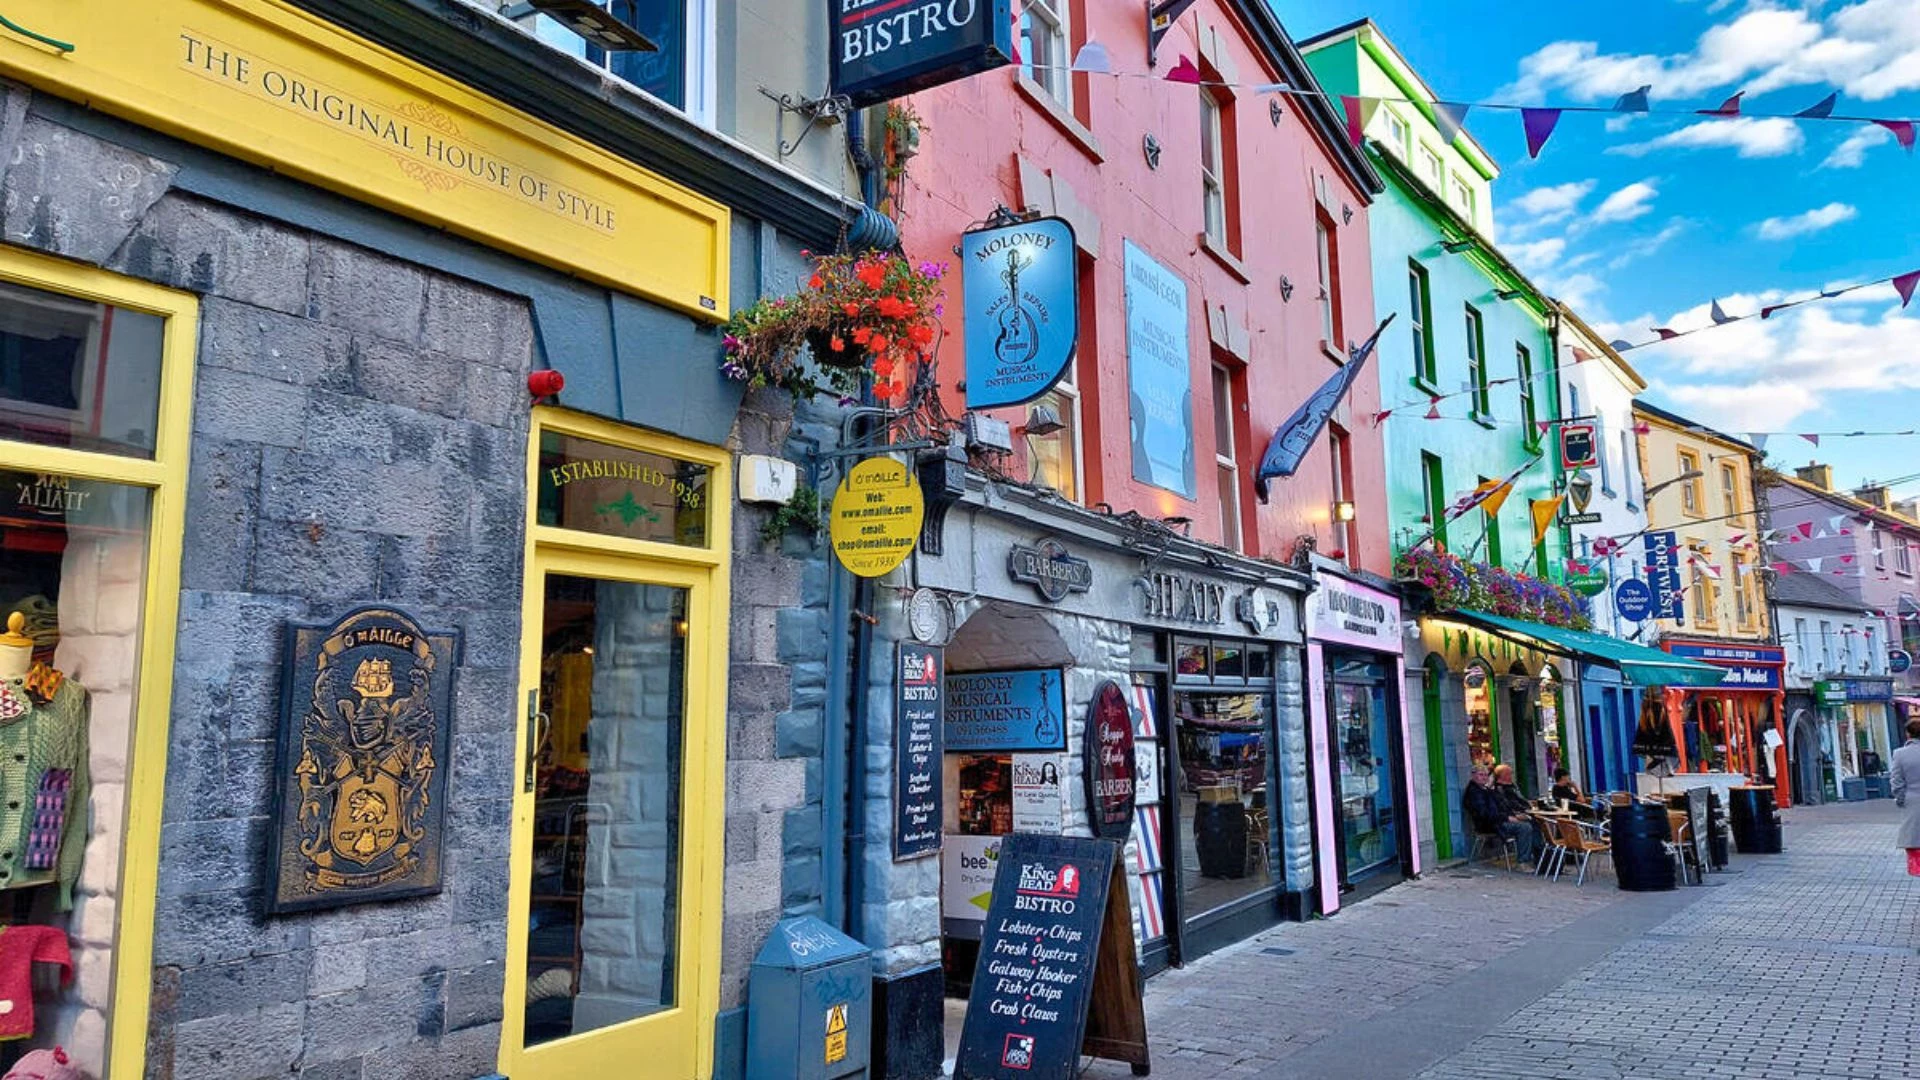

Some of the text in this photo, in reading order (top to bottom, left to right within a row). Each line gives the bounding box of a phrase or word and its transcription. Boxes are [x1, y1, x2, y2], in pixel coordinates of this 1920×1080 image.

[841, 0, 976, 64] BISTRO
[180, 34, 616, 231] THE ORIGINAL HOUSE OF STYLE
[975, 232, 1055, 263] MOLONEY
[986, 291, 1049, 324] SALES REPAIRS
[985, 372, 1050, 388] INSTRUMENTS
[996, 363, 1038, 377] MUSICAL
[550, 459, 701, 509] ESTABLISHED 1938
[1563, 515, 1600, 523] GUINNESS
[1026, 555, 1081, 584] BARBERS
[1654, 535, 1674, 617] PORTWEST
[1618, 596, 1649, 604] Outdoor
[1626, 588, 1640, 596] The
[903, 686, 938, 701] BISTRO
[948, 676, 1014, 692] MOLONEY
[951, 691, 1012, 708] MUSICAL
[945, 707, 1032, 723] STRUMENTS
[1095, 778, 1133, 797] BARBER
[961, 874, 974, 884] Dry
[1019, 877, 1054, 891] HEAD
[1014, 895, 1075, 915] BISTRO
[999, 918, 1044, 936] Lobster
[1049, 924, 1083, 944] Chips
[993, 939, 1078, 963] Fresh Oysters
[988, 960, 1078, 984] Galway Hooker
[996, 978, 1022, 994] Fish
[1029, 982, 1064, 1004] Chips
[990, 999, 1059, 1022] Crab Claws
